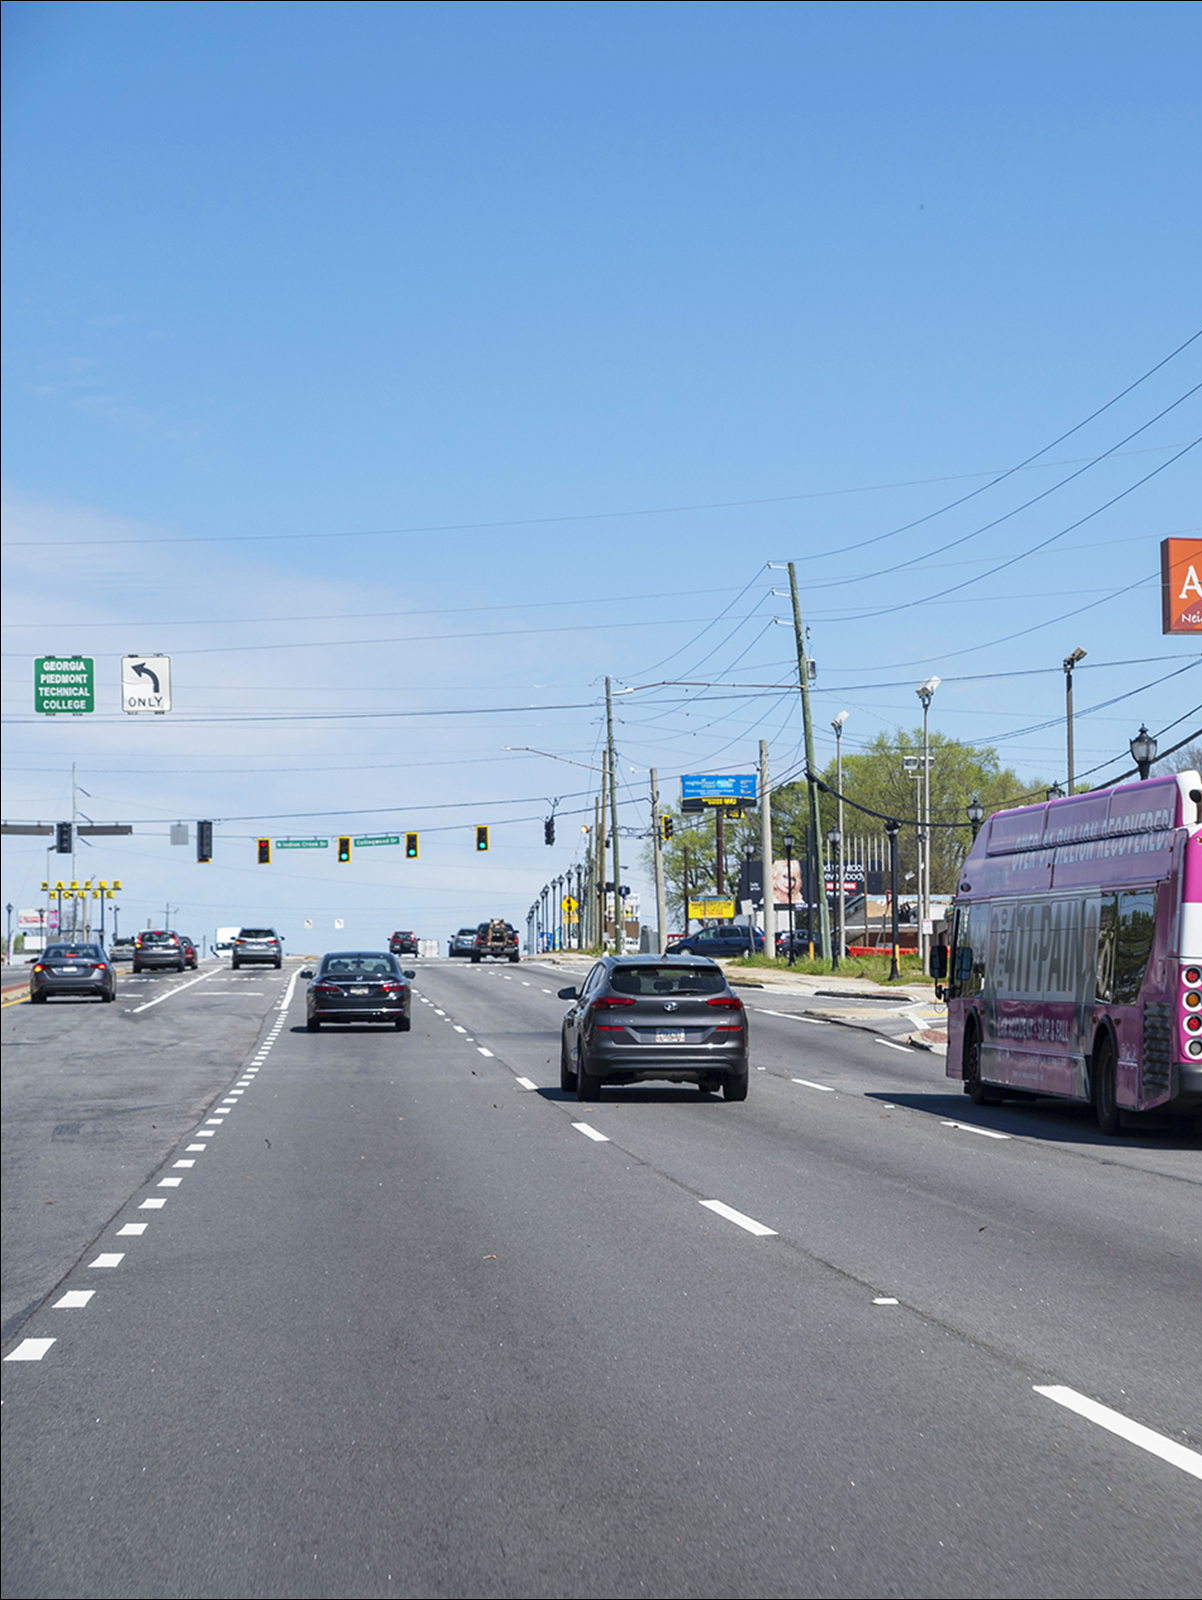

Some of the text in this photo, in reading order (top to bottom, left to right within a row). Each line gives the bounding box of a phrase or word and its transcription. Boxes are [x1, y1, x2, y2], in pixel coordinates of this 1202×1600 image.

[42, 661, 86, 671] GEORGIA
[40, 674, 88, 684] PIEDMONT
[38, 687, 90, 697] TECHNICAL
[42, 699, 86, 710] COLLEGE
[128, 696, 163, 707] ONLY
